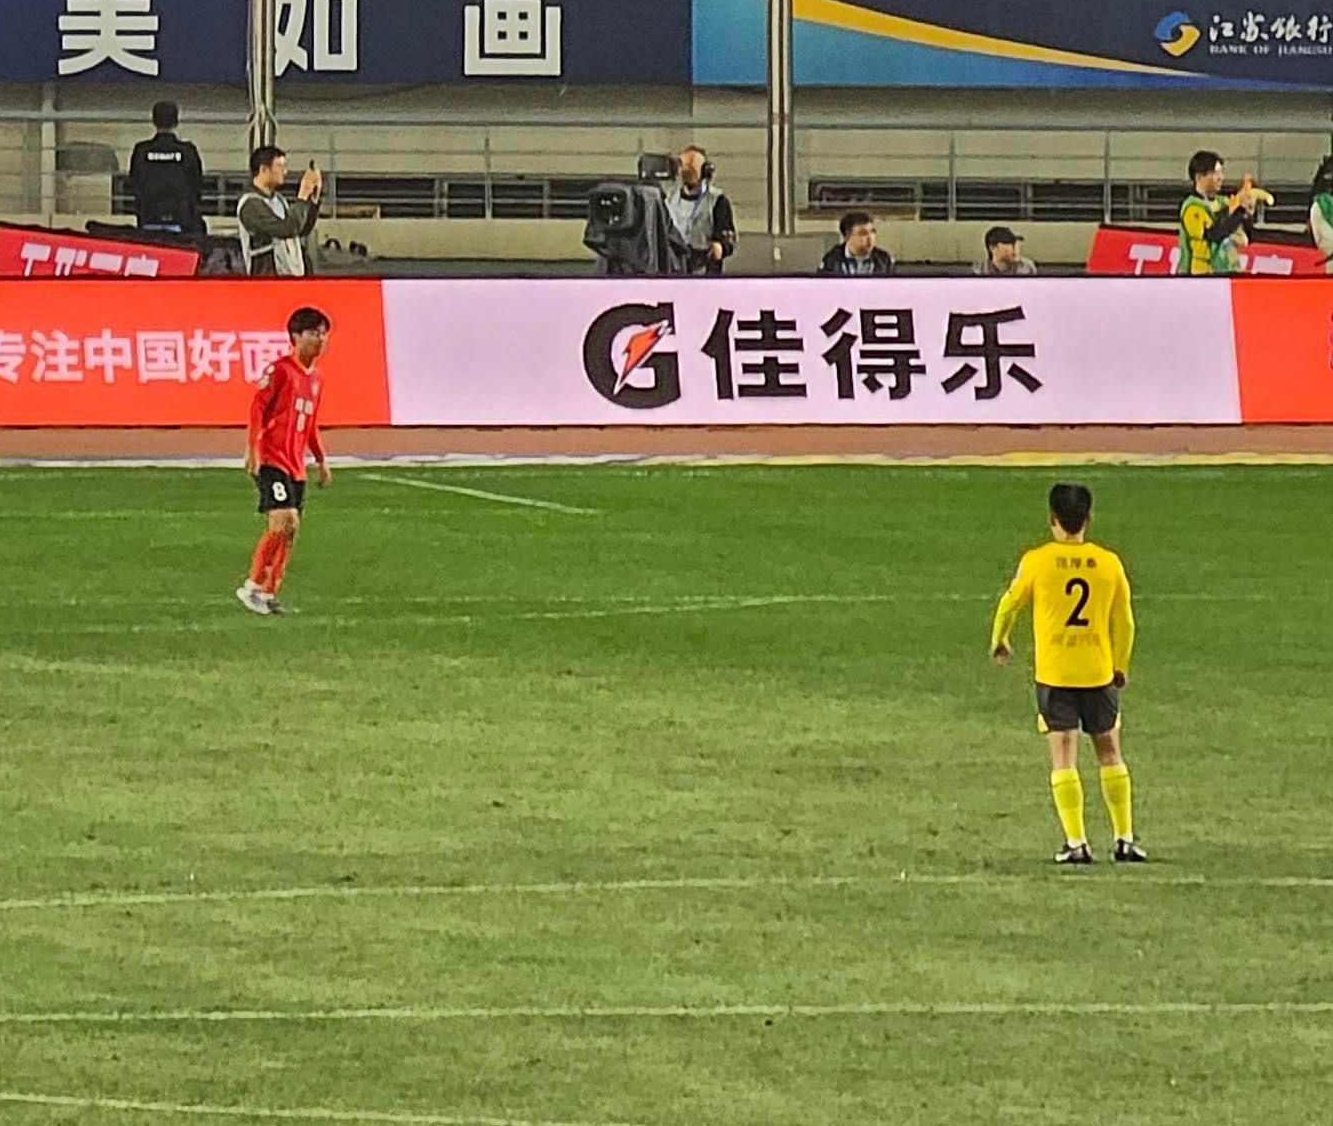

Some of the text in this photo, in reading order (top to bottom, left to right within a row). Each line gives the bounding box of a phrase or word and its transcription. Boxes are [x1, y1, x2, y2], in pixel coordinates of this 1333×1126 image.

[1209, 10, 1333, 43] 江苏银行
[700, 305, 1044, 402] 佳得乐
[272, 481, 288, 502] 8
[1064, 577, 1090, 627] 2
